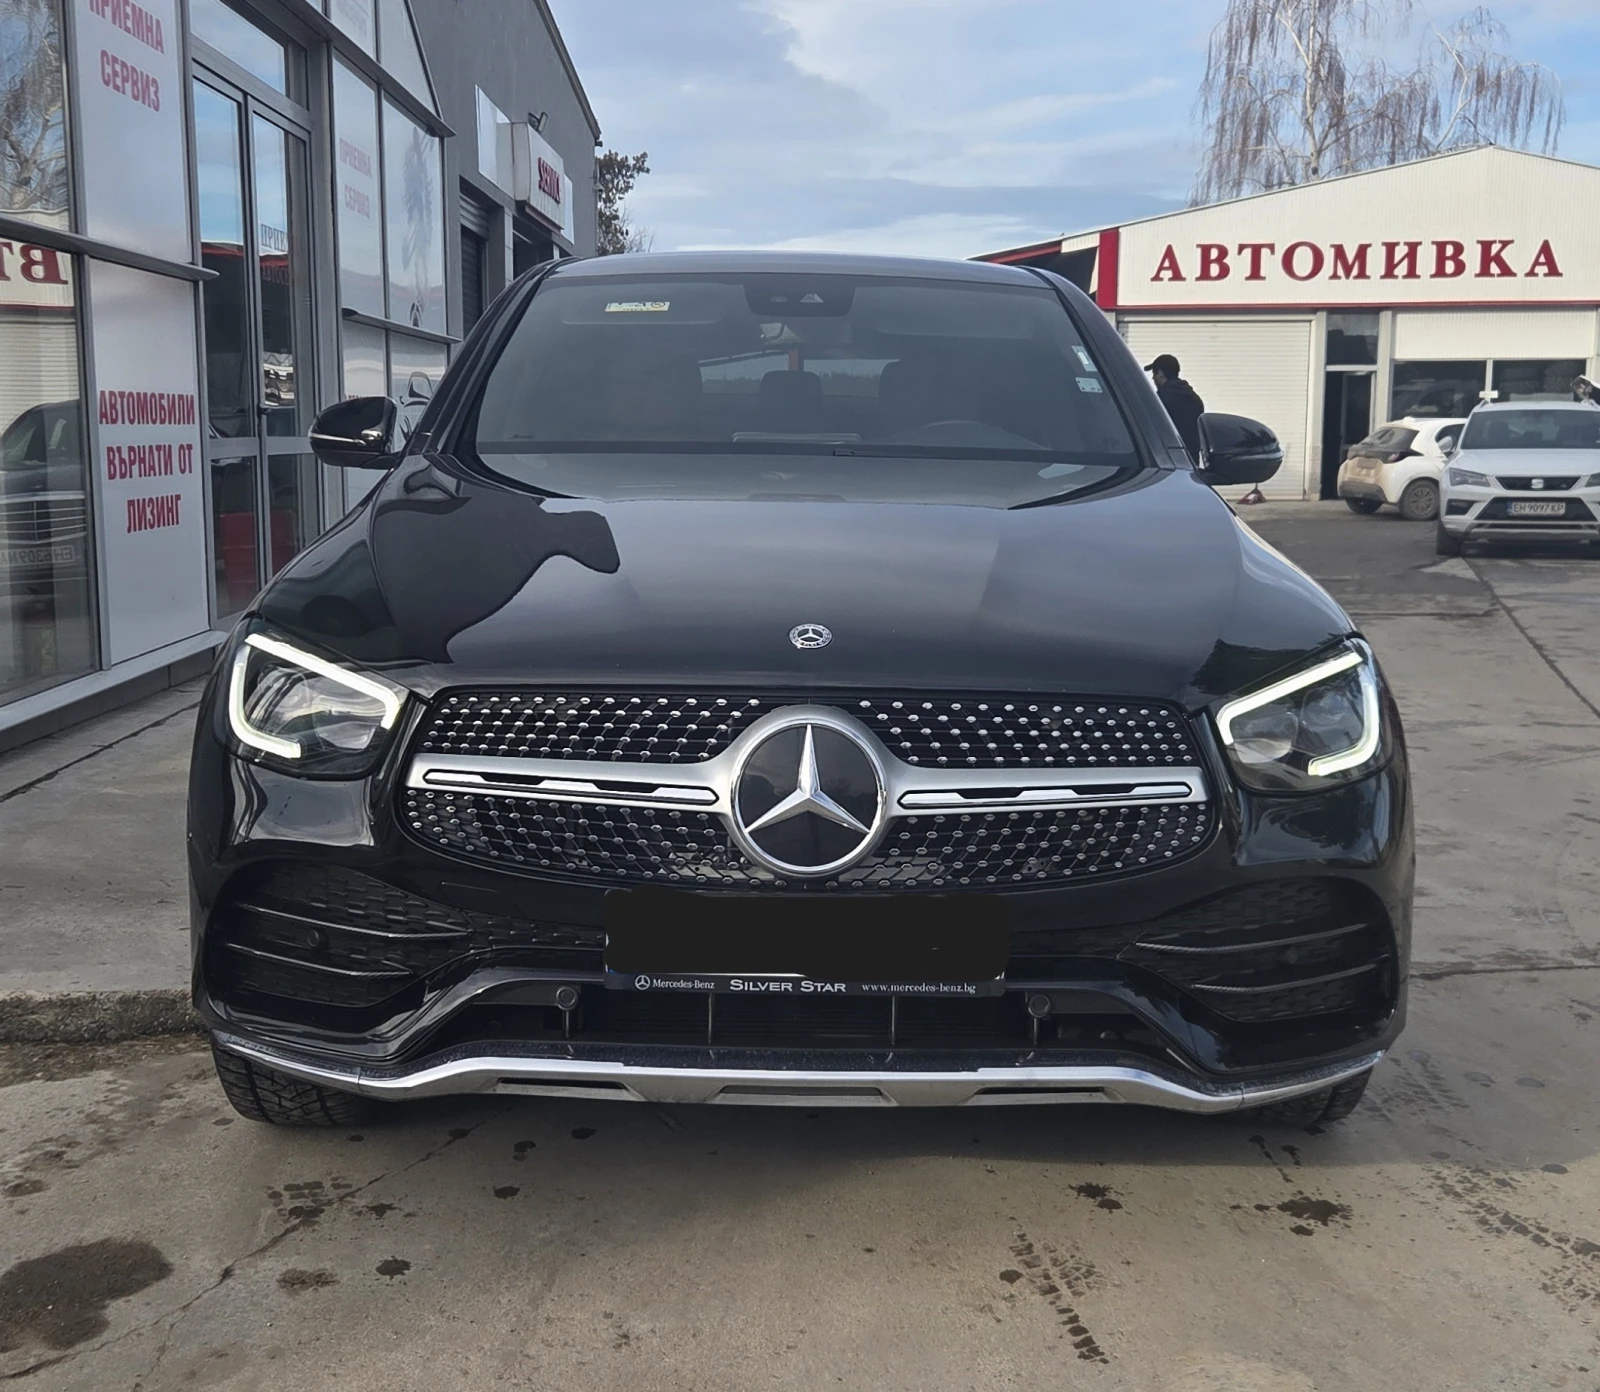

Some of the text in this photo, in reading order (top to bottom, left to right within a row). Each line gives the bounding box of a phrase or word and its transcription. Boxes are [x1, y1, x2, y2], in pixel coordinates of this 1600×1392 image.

[100, 49, 160, 112] СЕРВИЗ
[1150, 239, 1563, 281] АВТОМИВКА
[99, 390, 195, 425] АВТОМОБИЛИ
[106, 443, 193, 480] ВЪРНАТИ ОТ
[127, 494, 181, 533] ЛИЗИНГ
[653, 979, 977, 994] Mercedes-Benz SILVER STAR www.mercedes-benz.bg
